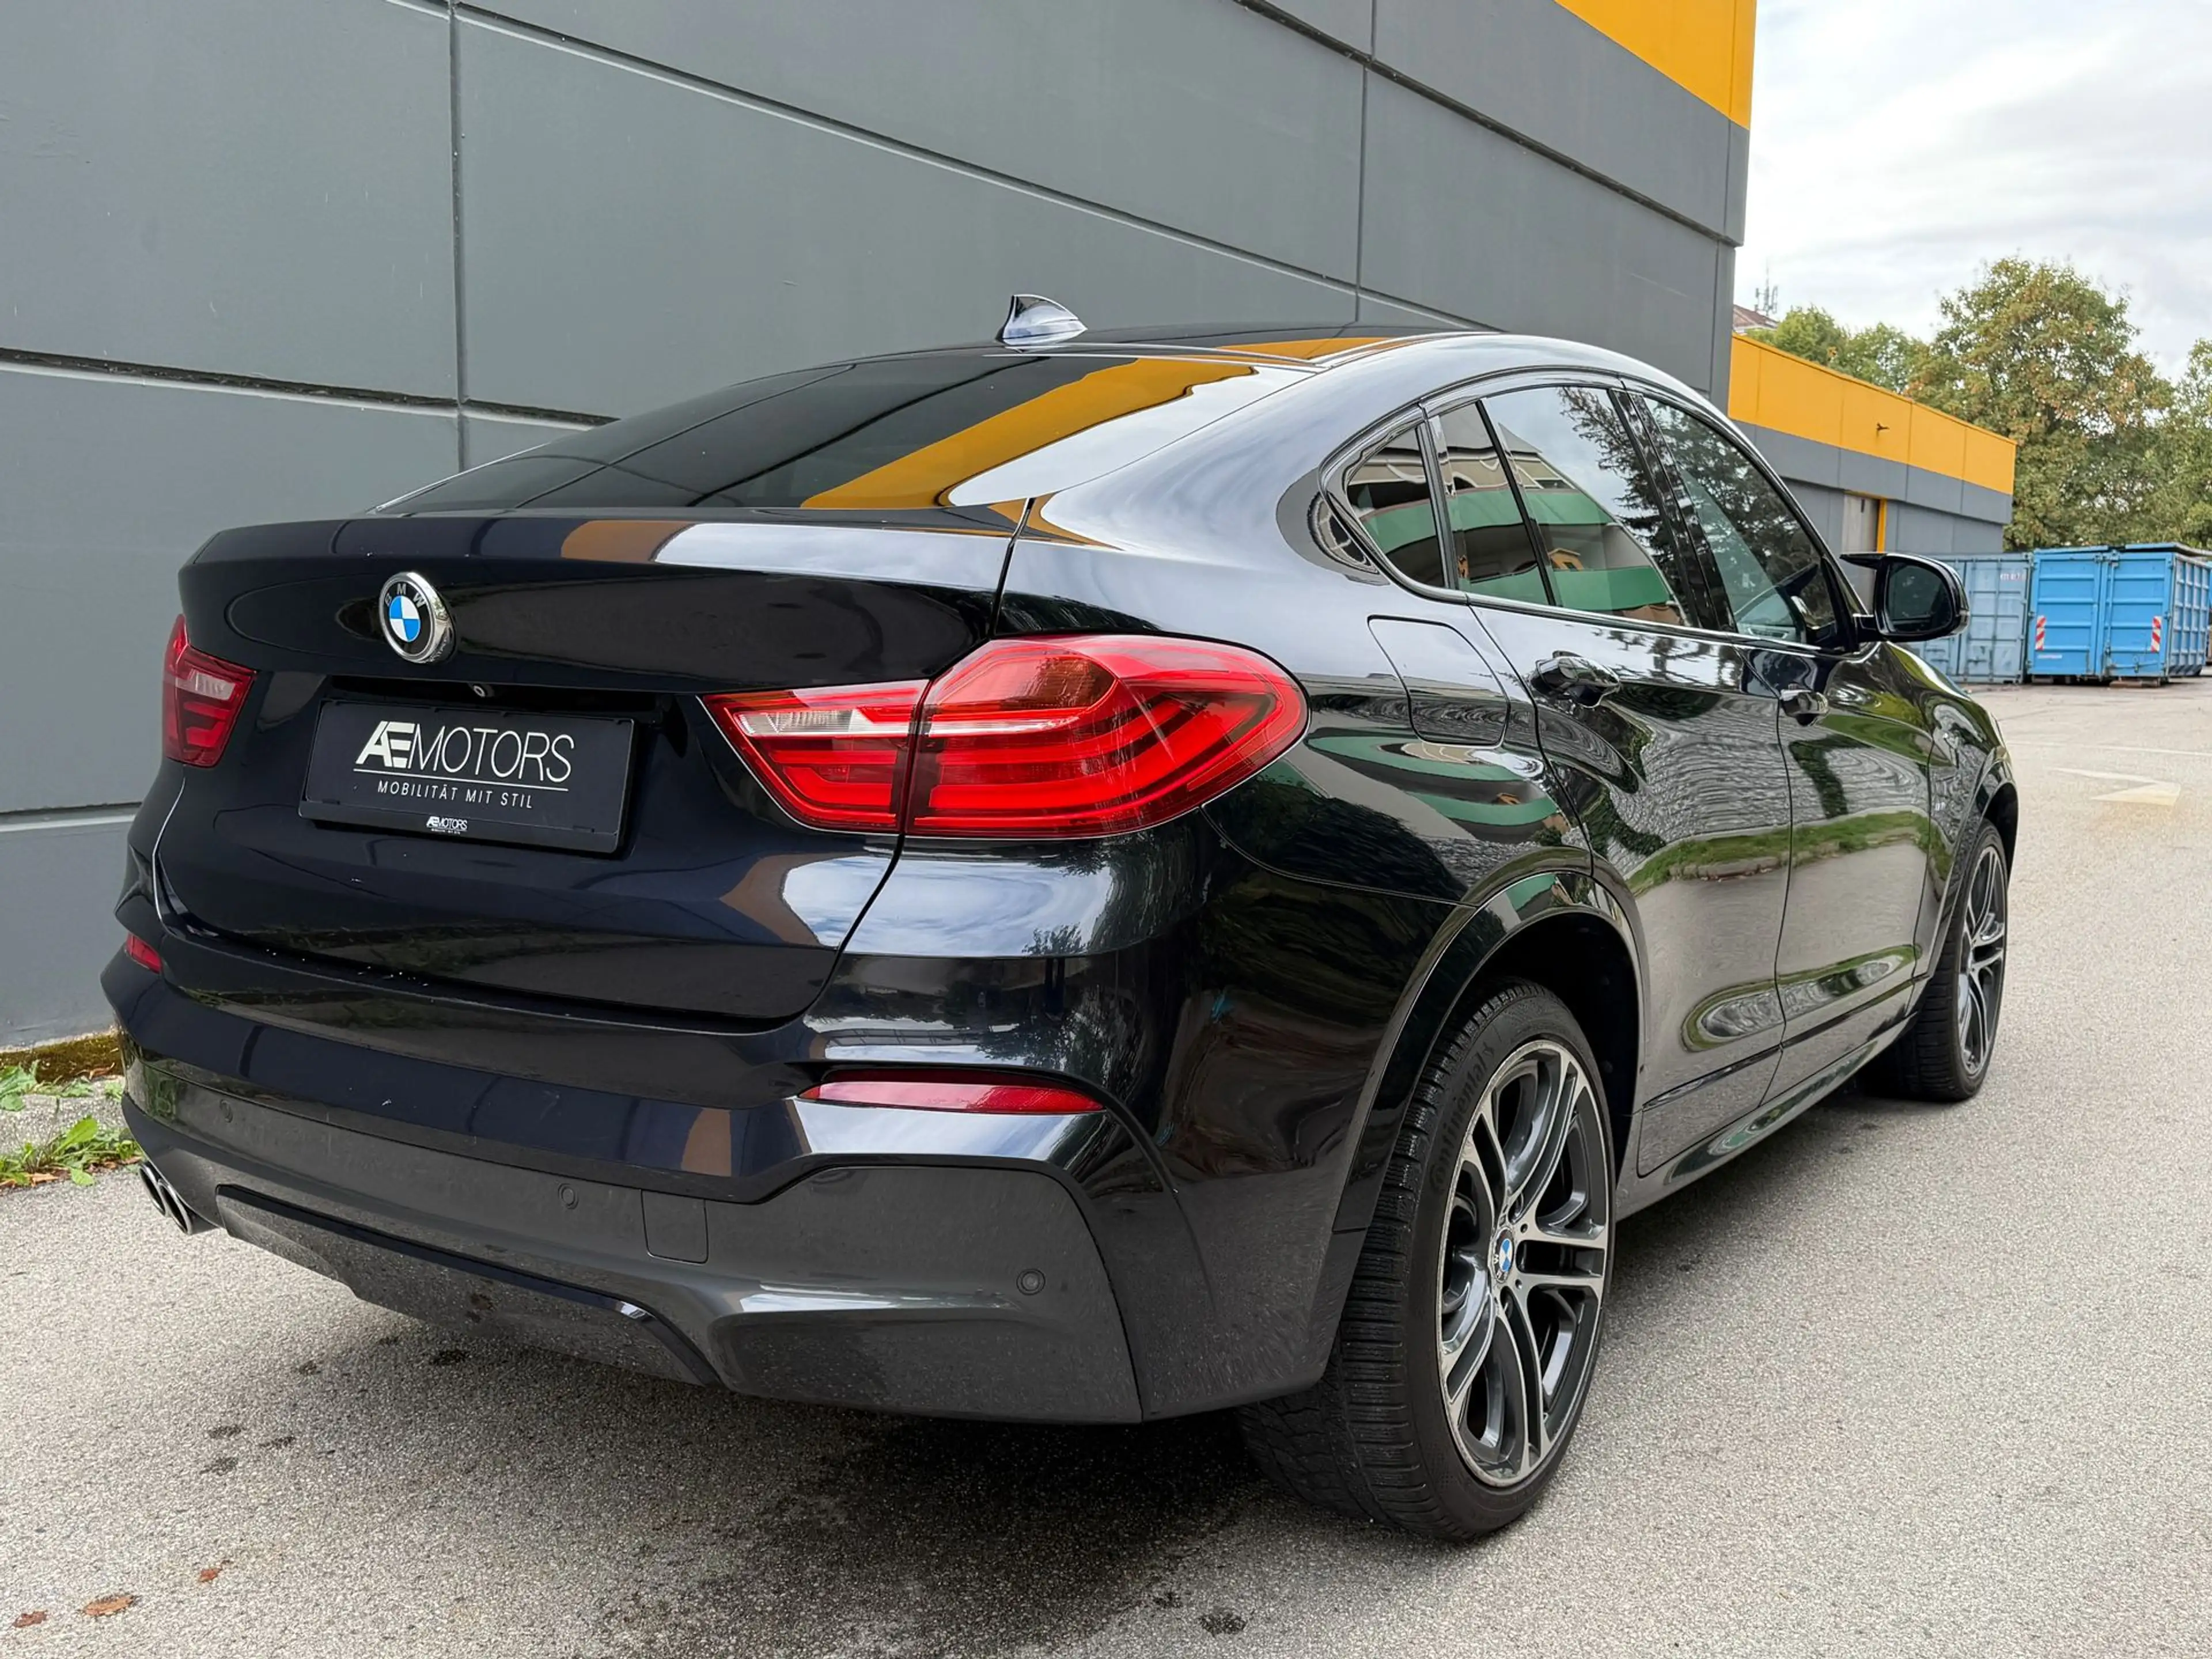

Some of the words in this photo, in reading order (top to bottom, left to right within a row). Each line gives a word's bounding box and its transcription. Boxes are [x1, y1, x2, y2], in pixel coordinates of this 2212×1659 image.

[384, 582, 426, 608] BMW
[377, 780, 458, 801] MOBILITÄT
[465, 789, 493, 805] MIT
[500, 792, 533, 809] STIL
